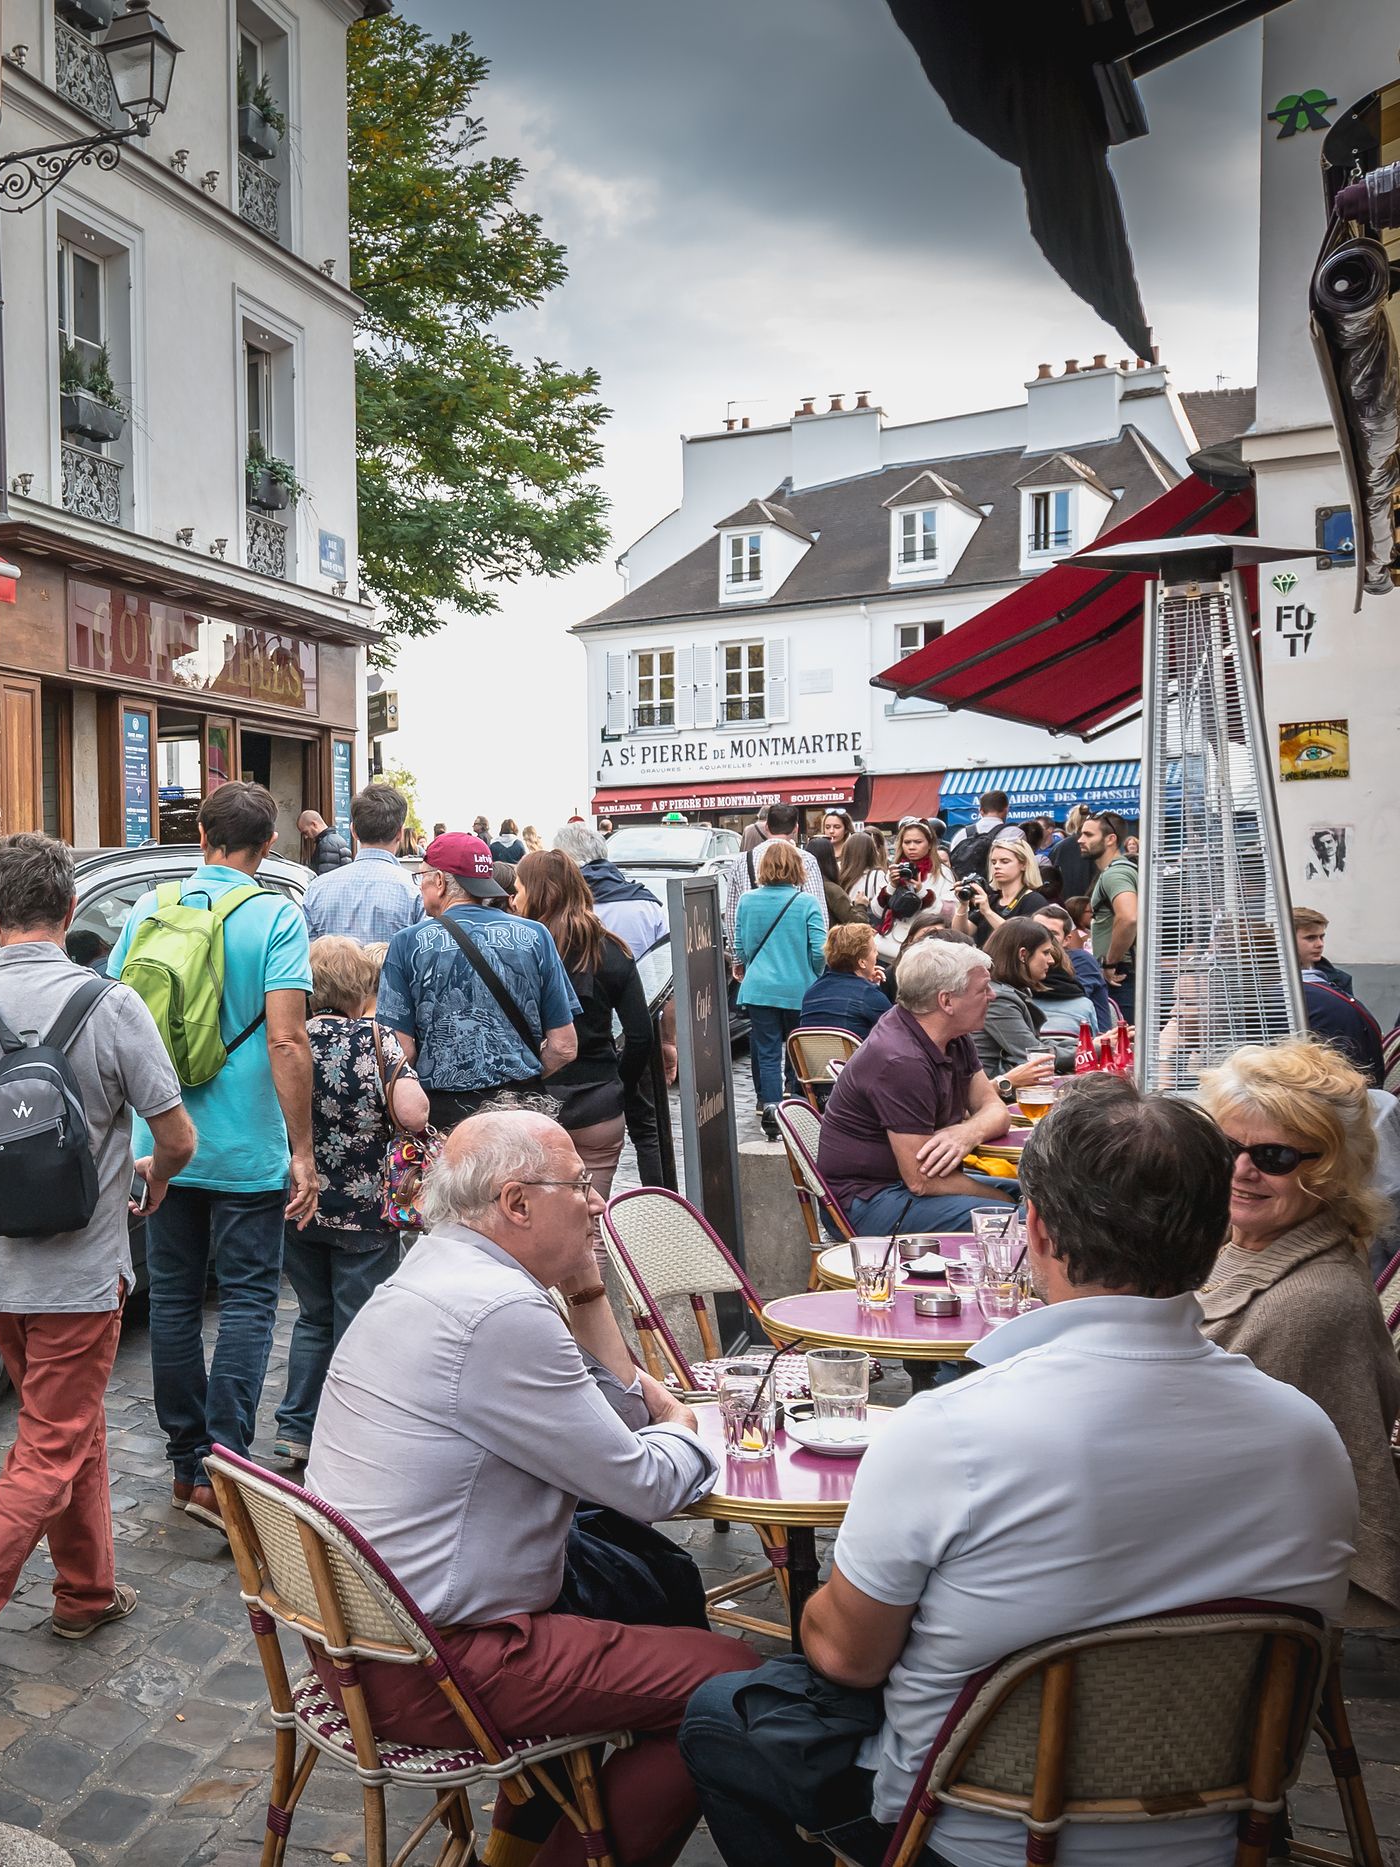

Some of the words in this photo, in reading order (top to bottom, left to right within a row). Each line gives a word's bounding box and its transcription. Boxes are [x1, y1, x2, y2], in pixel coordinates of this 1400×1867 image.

[601, 748, 614, 767] A
[641, 742, 708, 765] PIERRE
[713, 749, 726, 760] DE
[730, 732, 862, 759] MONTMARTRE
[640, 766, 681, 775] GRAVURES
[699, 761, 752, 771] AQUARELLES
[769, 758, 817, 766] PEINTURES
[599, 804, 642, 813] TABLEAUX
[652, 801, 659, 811] A
[669, 797, 701, 809] PIERRE
[703, 796, 715, 808] DE
[717, 794, 781, 807] MONTMARTRE
[790, 792, 845, 803] SOUVENIRS
[1011, 793, 1047, 805] AIRON
[1054, 791, 1078, 802] DES
[1007, 810, 1055, 819] AMBIANCE
[696, 984, 713, 1037] Café
